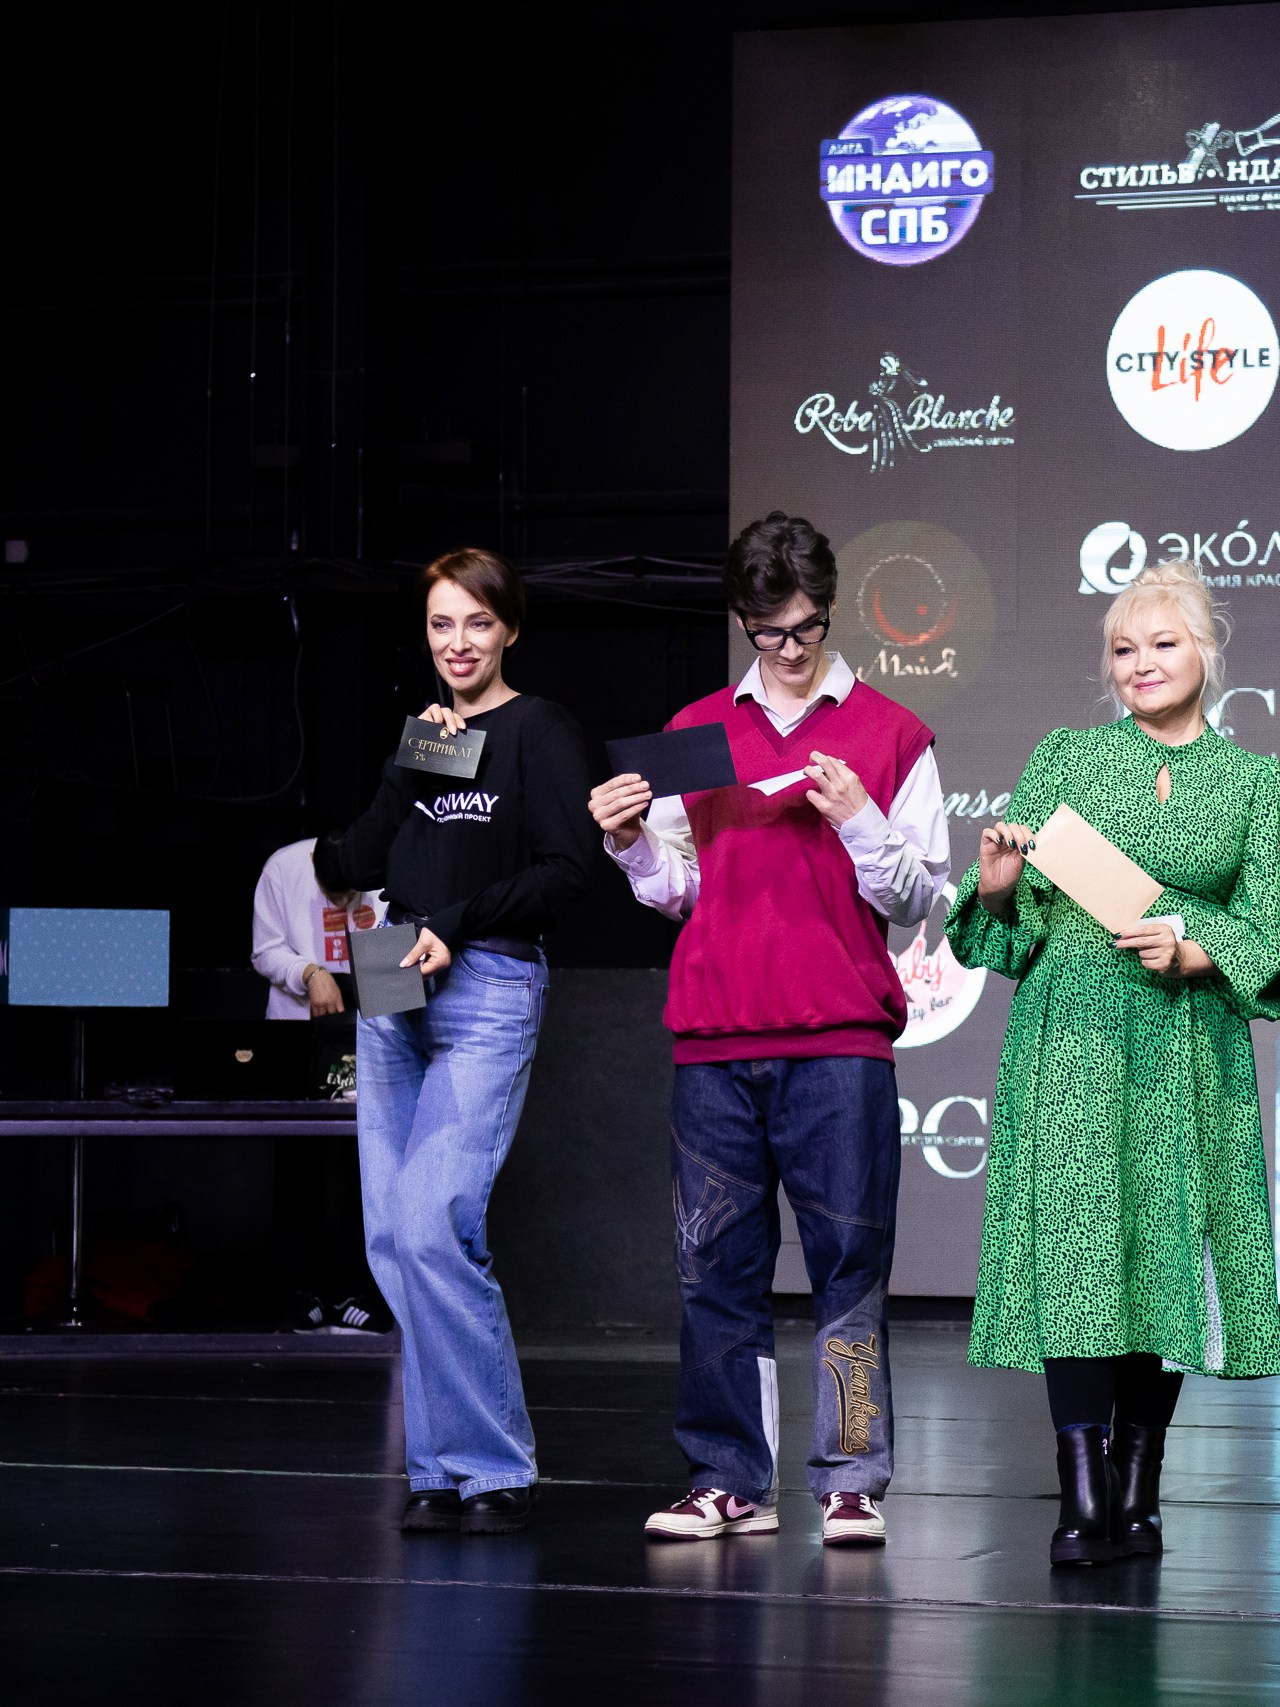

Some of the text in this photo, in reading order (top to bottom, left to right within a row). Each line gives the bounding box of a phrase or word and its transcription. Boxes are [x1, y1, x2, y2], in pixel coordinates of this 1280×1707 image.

[827, 159, 989, 195] ИНДИГО
[861, 206, 949, 245] СПБ
[464, 813, 492, 823] ПРОЕКТ
